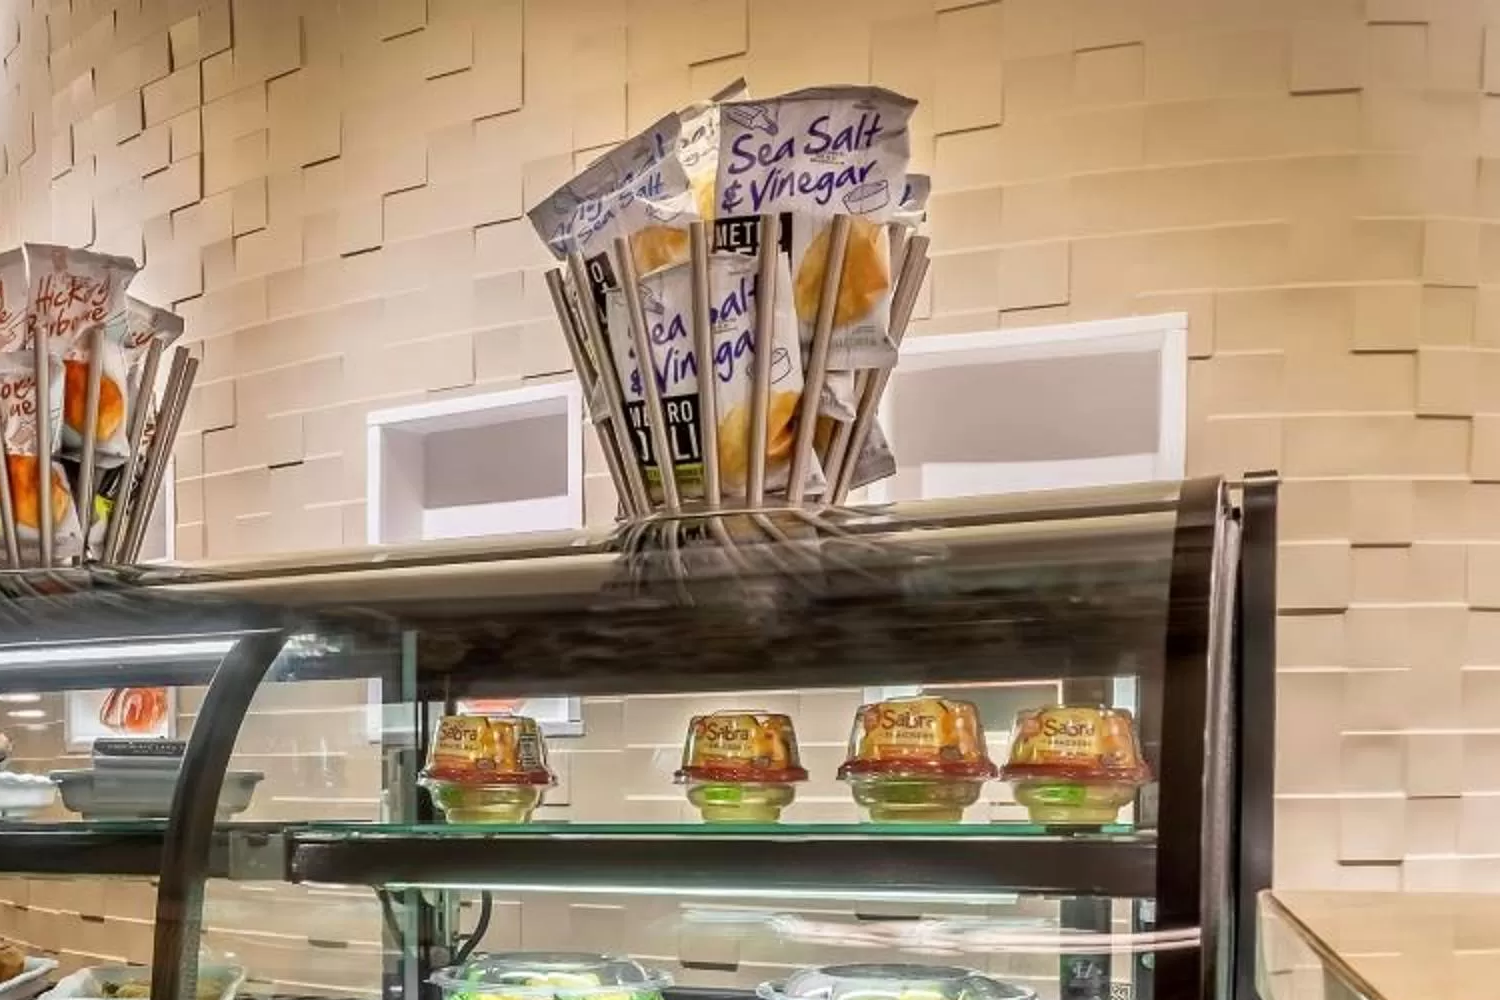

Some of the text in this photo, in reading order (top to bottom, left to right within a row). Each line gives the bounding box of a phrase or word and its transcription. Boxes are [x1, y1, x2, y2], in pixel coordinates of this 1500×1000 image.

[727, 133, 795, 175] Sea
[803, 112, 884, 155] Salt
[750, 159, 878, 213] Vinegar
[716, 221, 782, 247] MET
[652, 329, 757, 395] Vinga
[628, 399, 694, 429] MERO
